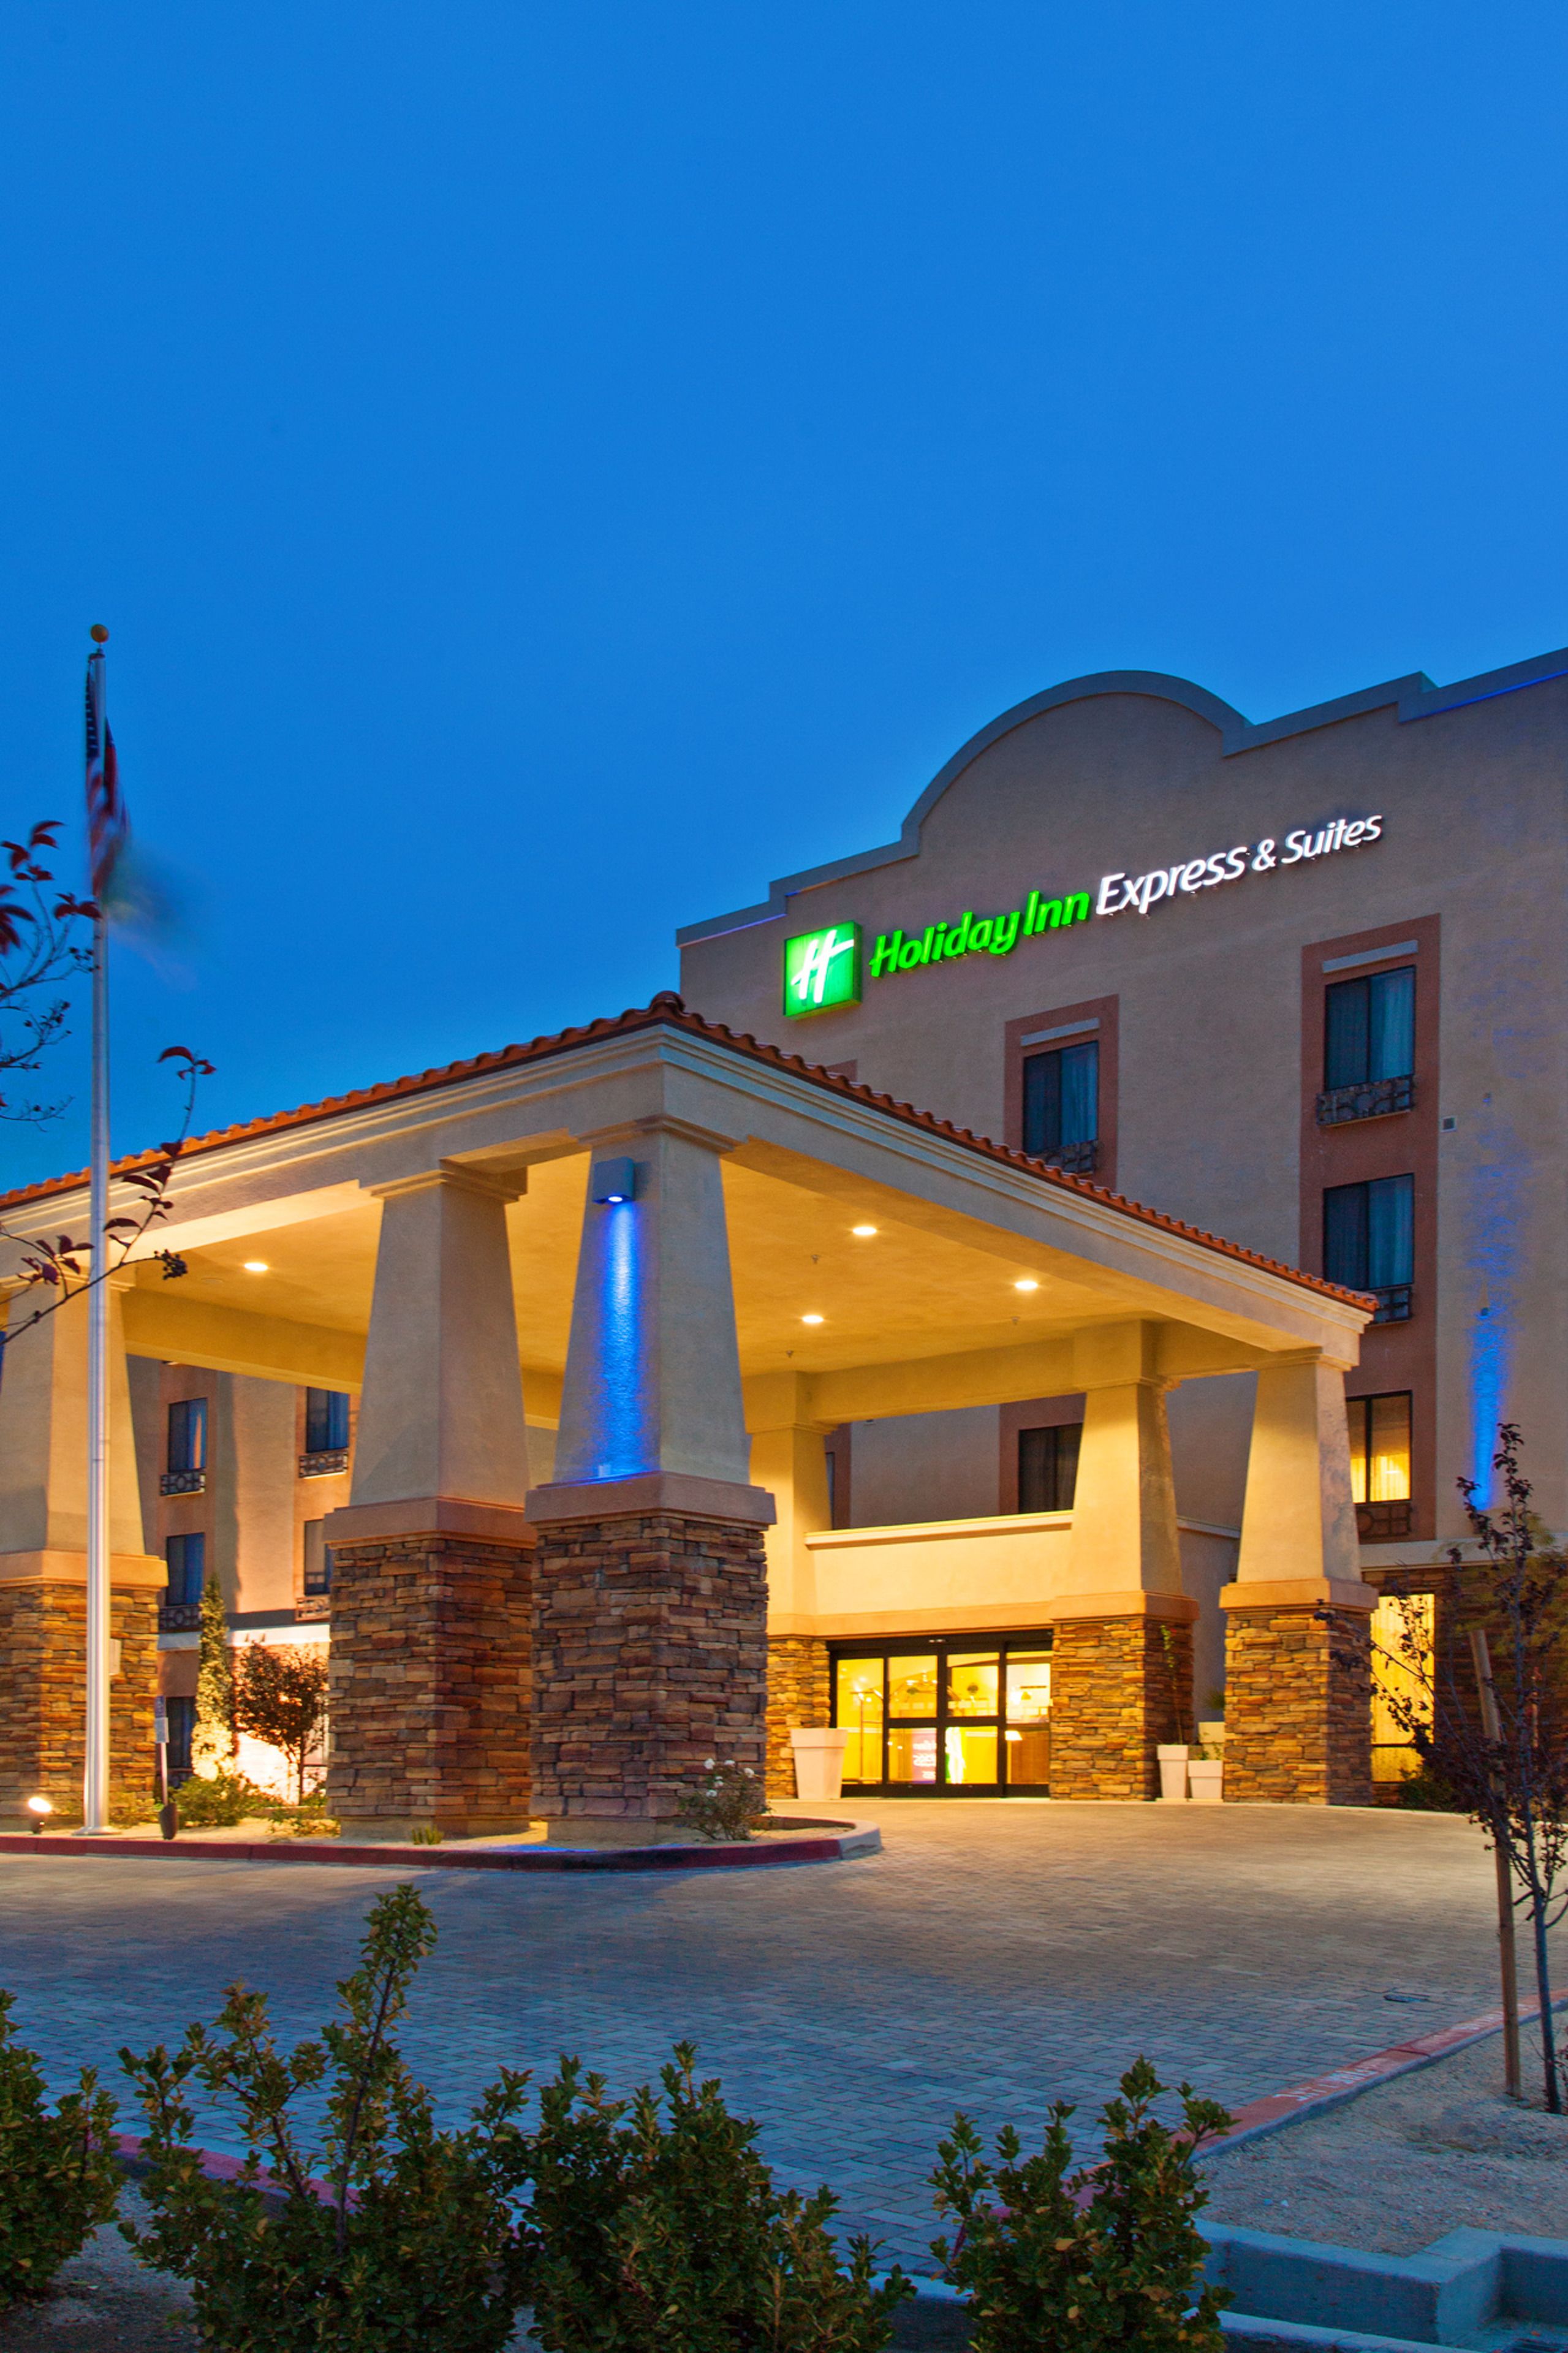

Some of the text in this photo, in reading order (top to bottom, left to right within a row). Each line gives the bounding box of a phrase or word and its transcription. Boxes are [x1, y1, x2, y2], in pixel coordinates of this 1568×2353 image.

[868, 814, 1383, 977] Holiday Inn Express & Suites
